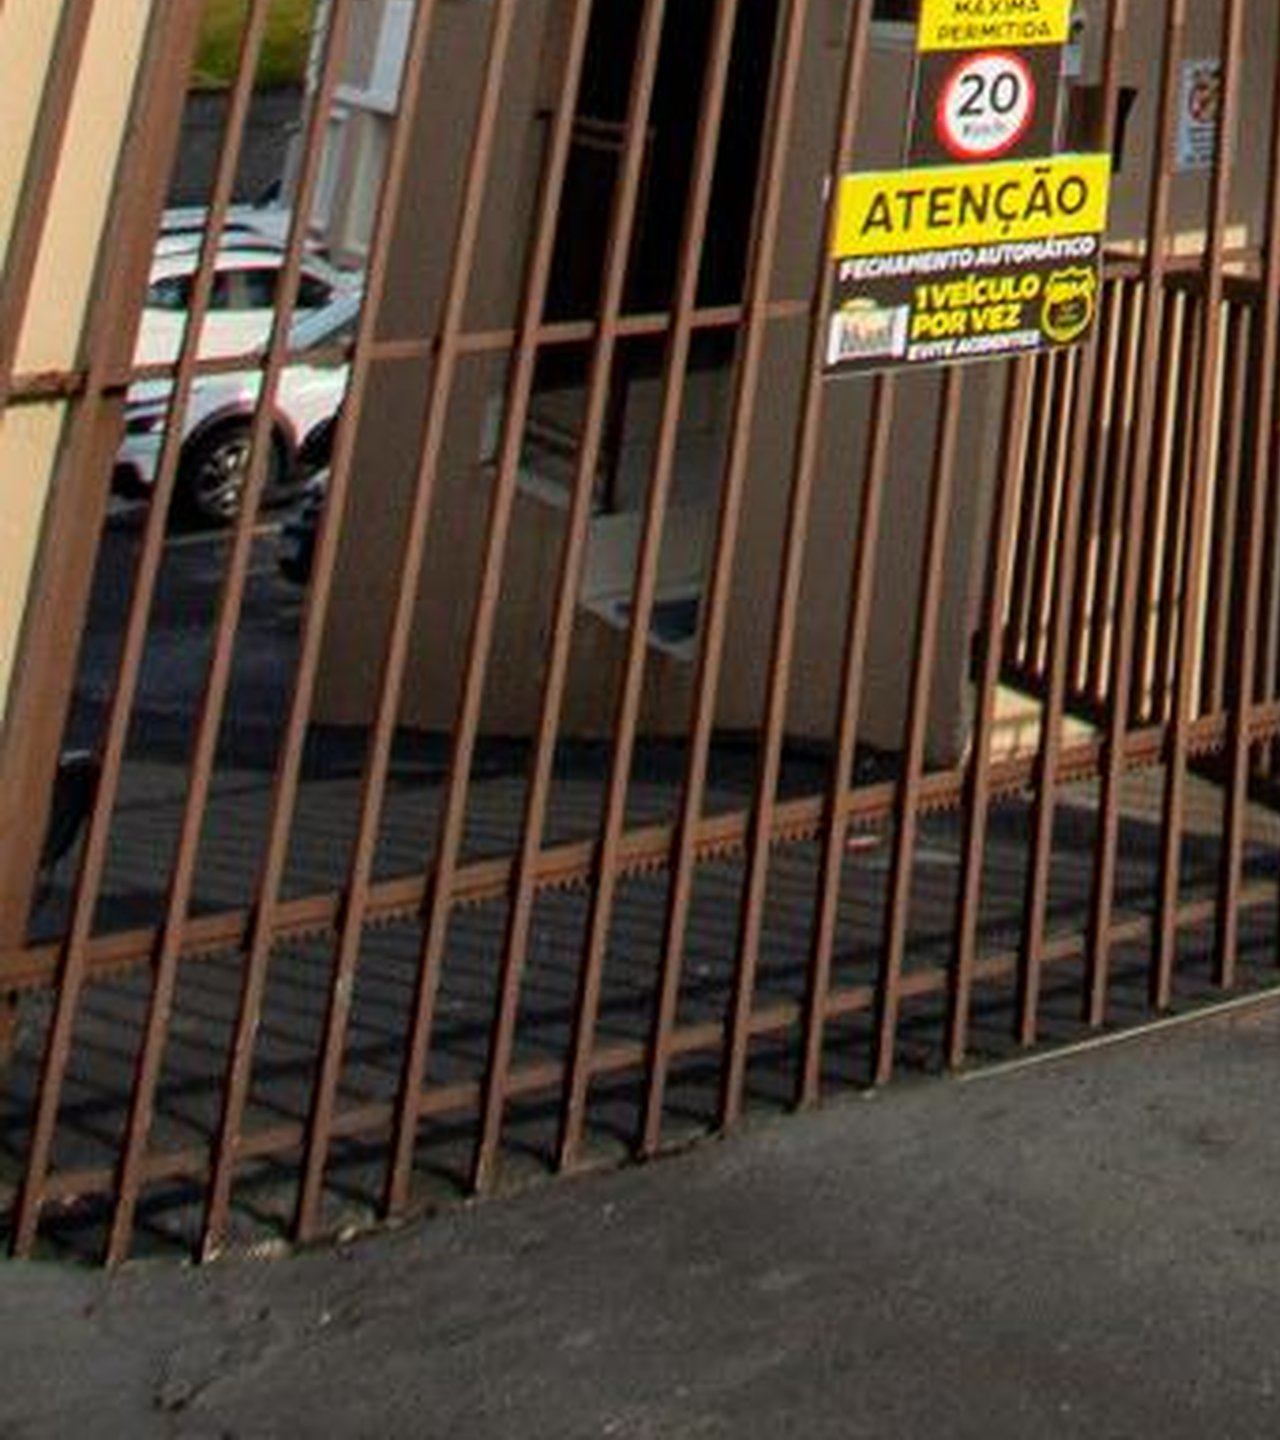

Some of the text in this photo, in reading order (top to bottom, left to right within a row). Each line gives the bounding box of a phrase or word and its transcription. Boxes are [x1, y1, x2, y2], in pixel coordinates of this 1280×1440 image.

[936, 21, 1052, 42] PERMITIDA
[958, 71, 1020, 116] 20
[860, 167, 1089, 235] ATENÇÃO
[839, 234, 1096, 281] FECHAMENTO AUTOMÁTICO
[915, 285, 928, 309] 1
[930, 273, 1040, 308] VEÍCULO
[910, 303, 1022, 339] POR VEZ
